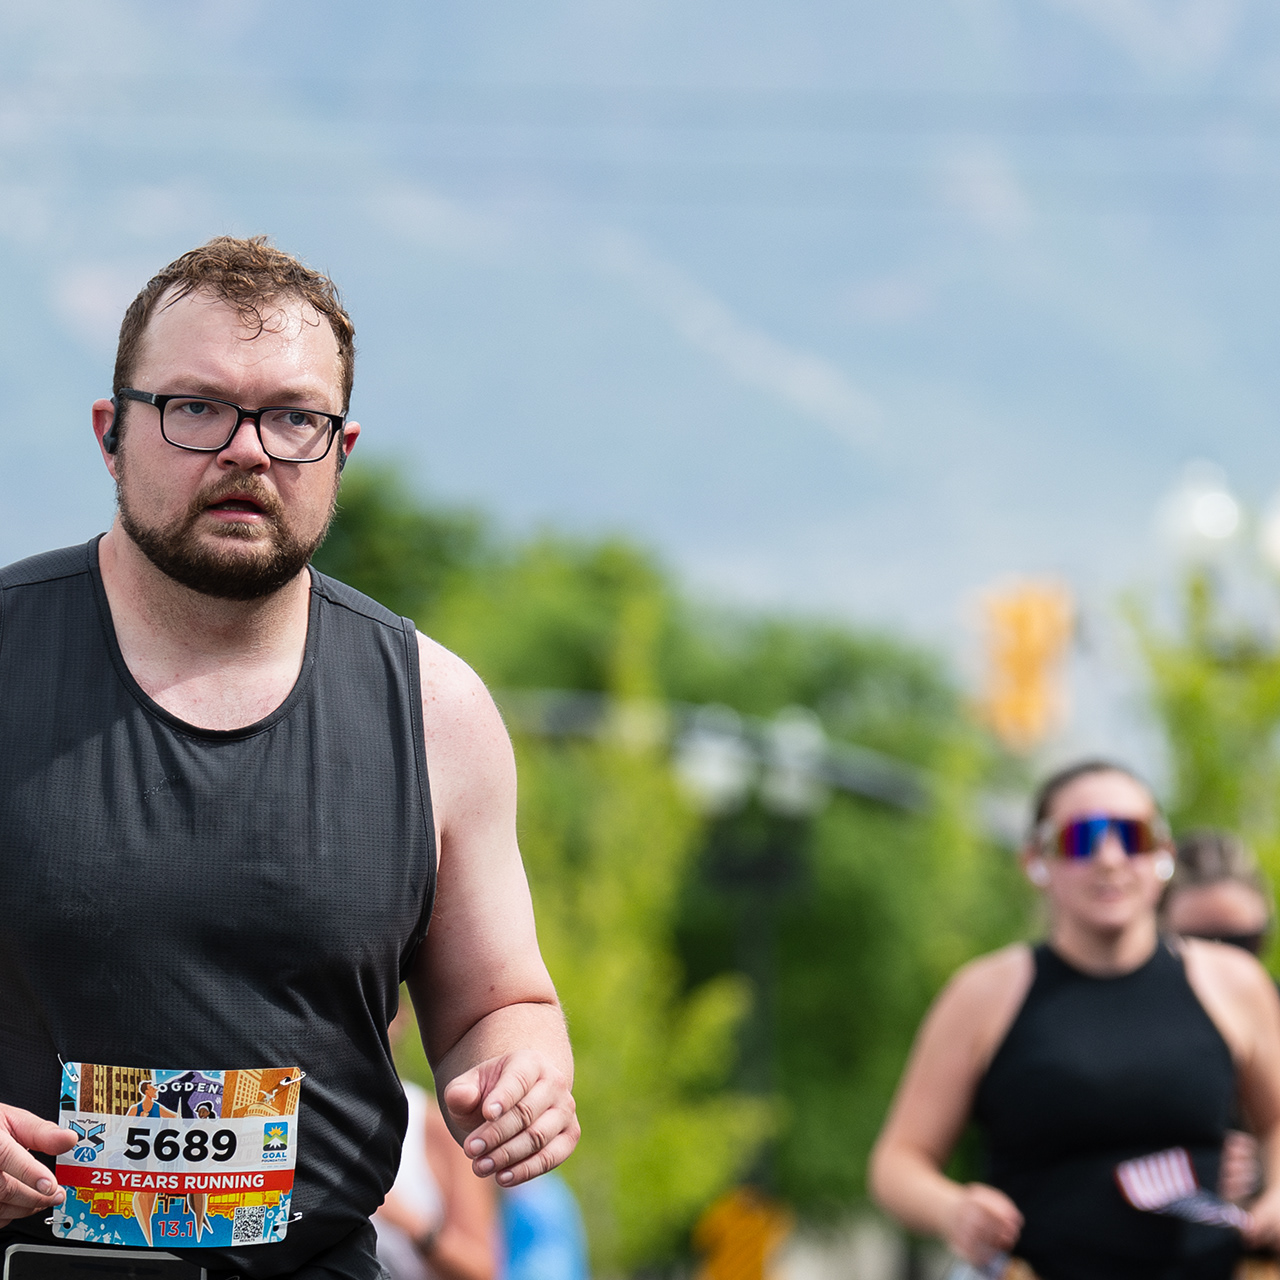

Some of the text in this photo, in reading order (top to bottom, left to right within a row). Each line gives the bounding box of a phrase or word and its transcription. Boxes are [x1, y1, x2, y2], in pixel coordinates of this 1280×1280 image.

[158, 1081, 219, 1095] OGDEN
[122, 1127, 237, 1163] 5689
[90, 1171, 265, 1190] 25 YEARS RUNNING
[158, 1221, 194, 1237] 13.1
